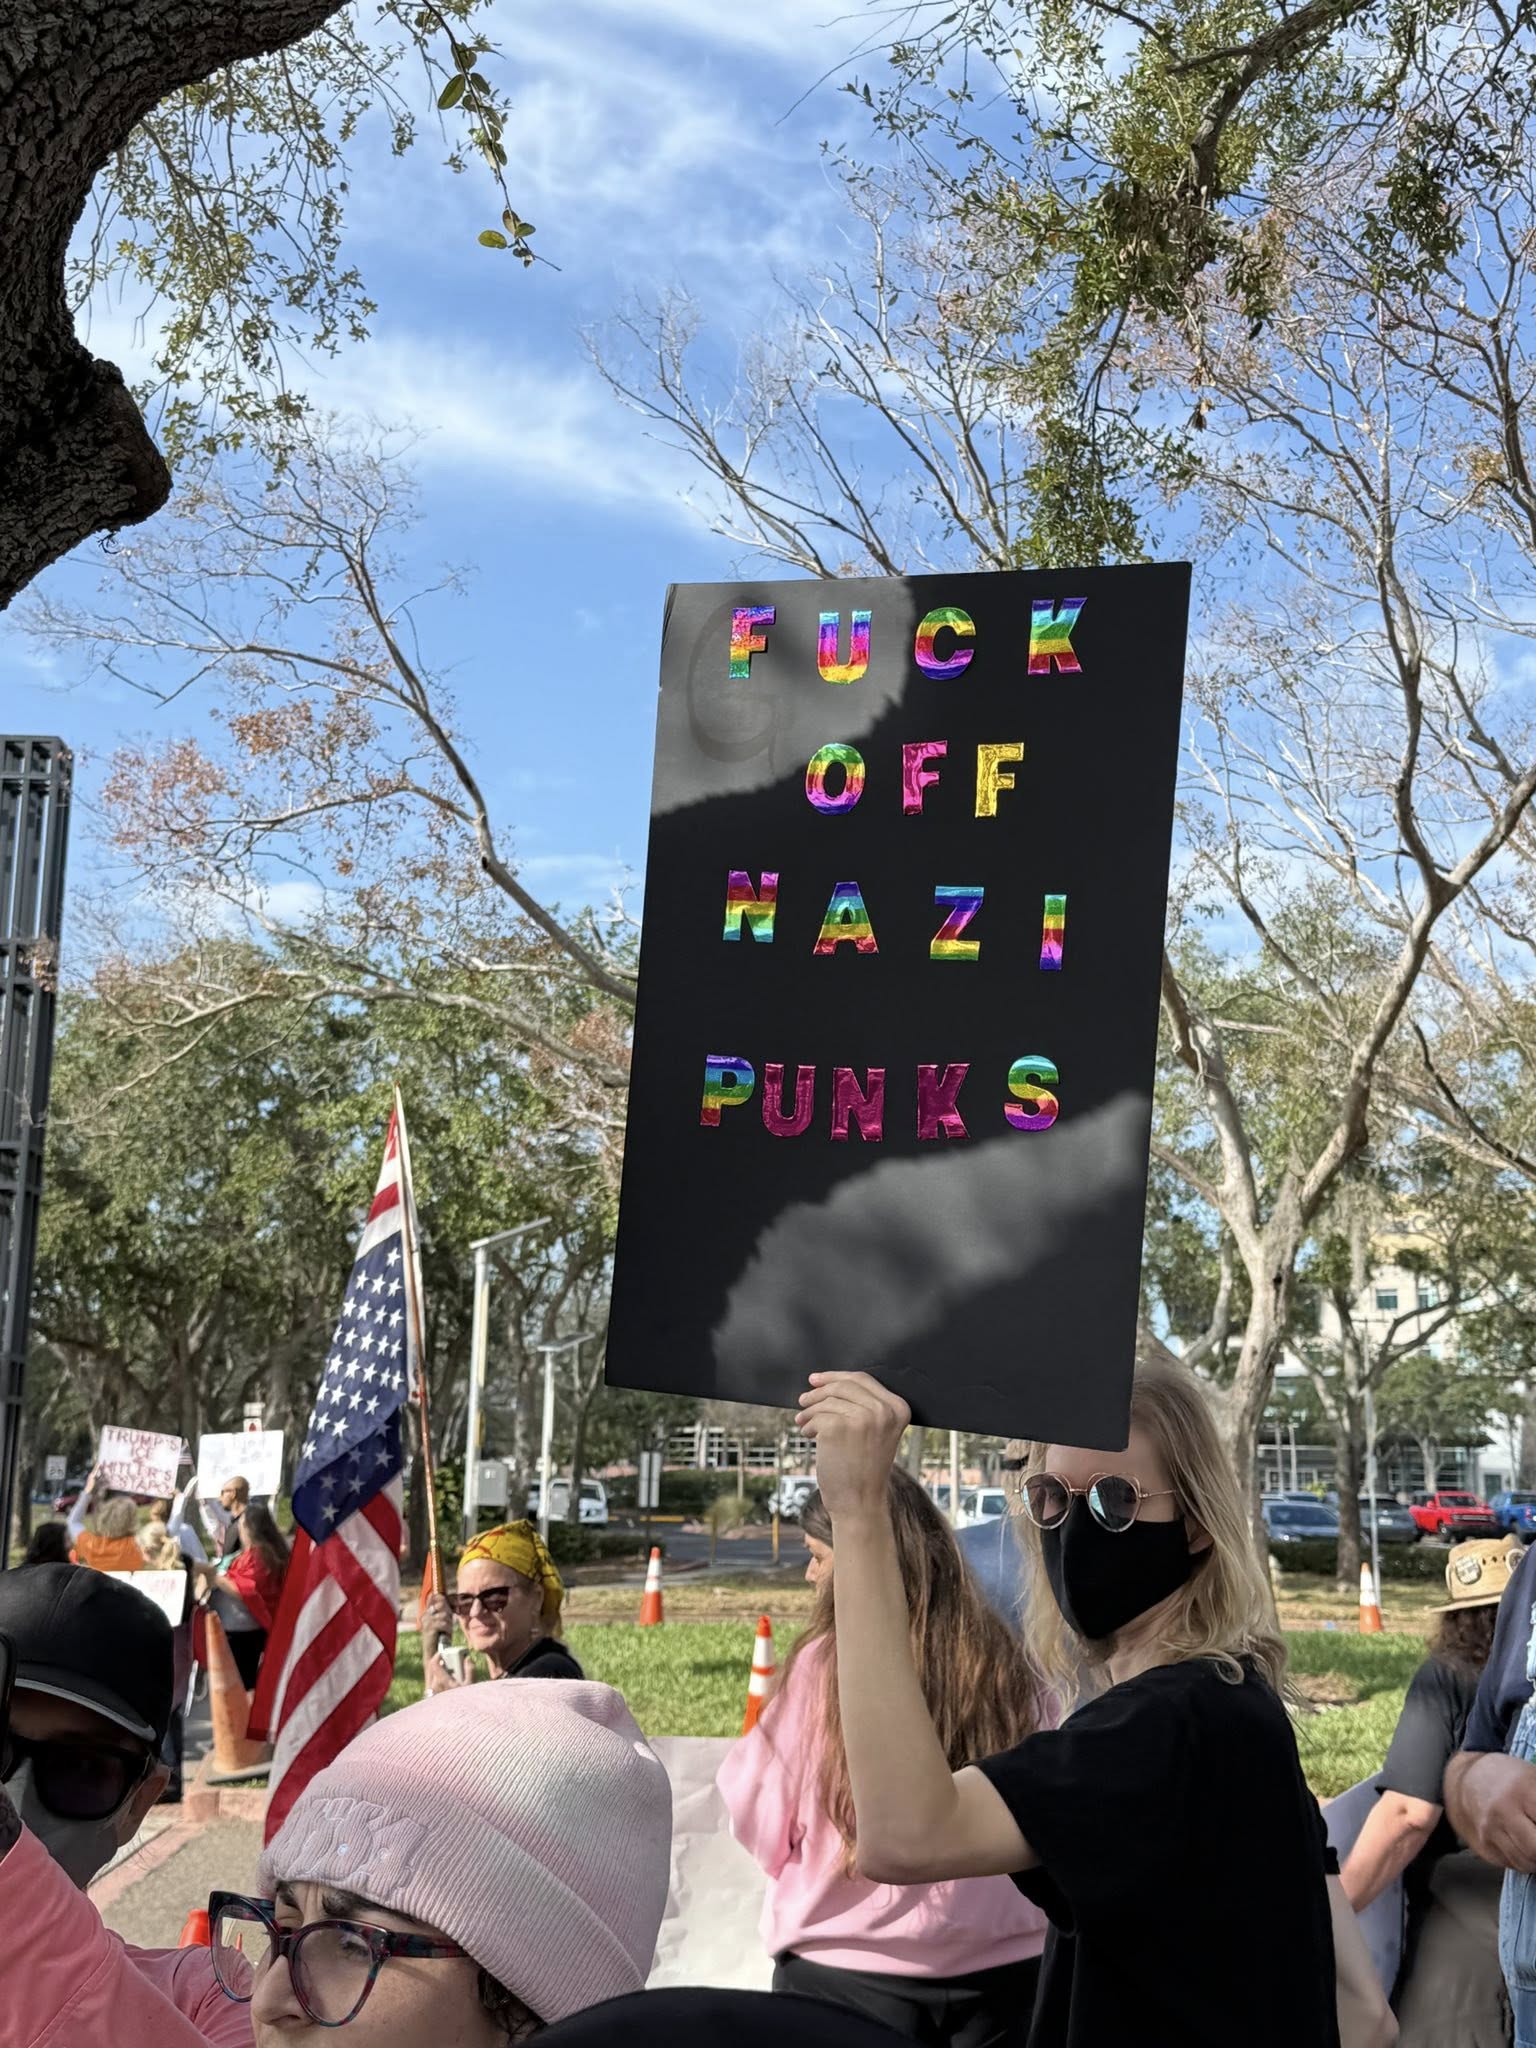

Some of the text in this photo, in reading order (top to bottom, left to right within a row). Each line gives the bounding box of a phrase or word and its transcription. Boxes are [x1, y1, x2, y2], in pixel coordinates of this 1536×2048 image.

[729, 597, 1088, 685] FUCK
[805, 740, 1025, 818] OFF
[722, 869, 1067, 971] NAZI
[700, 1053, 1060, 1142] PUNKS
[107, 1429, 178, 1451] TRUMP'S
